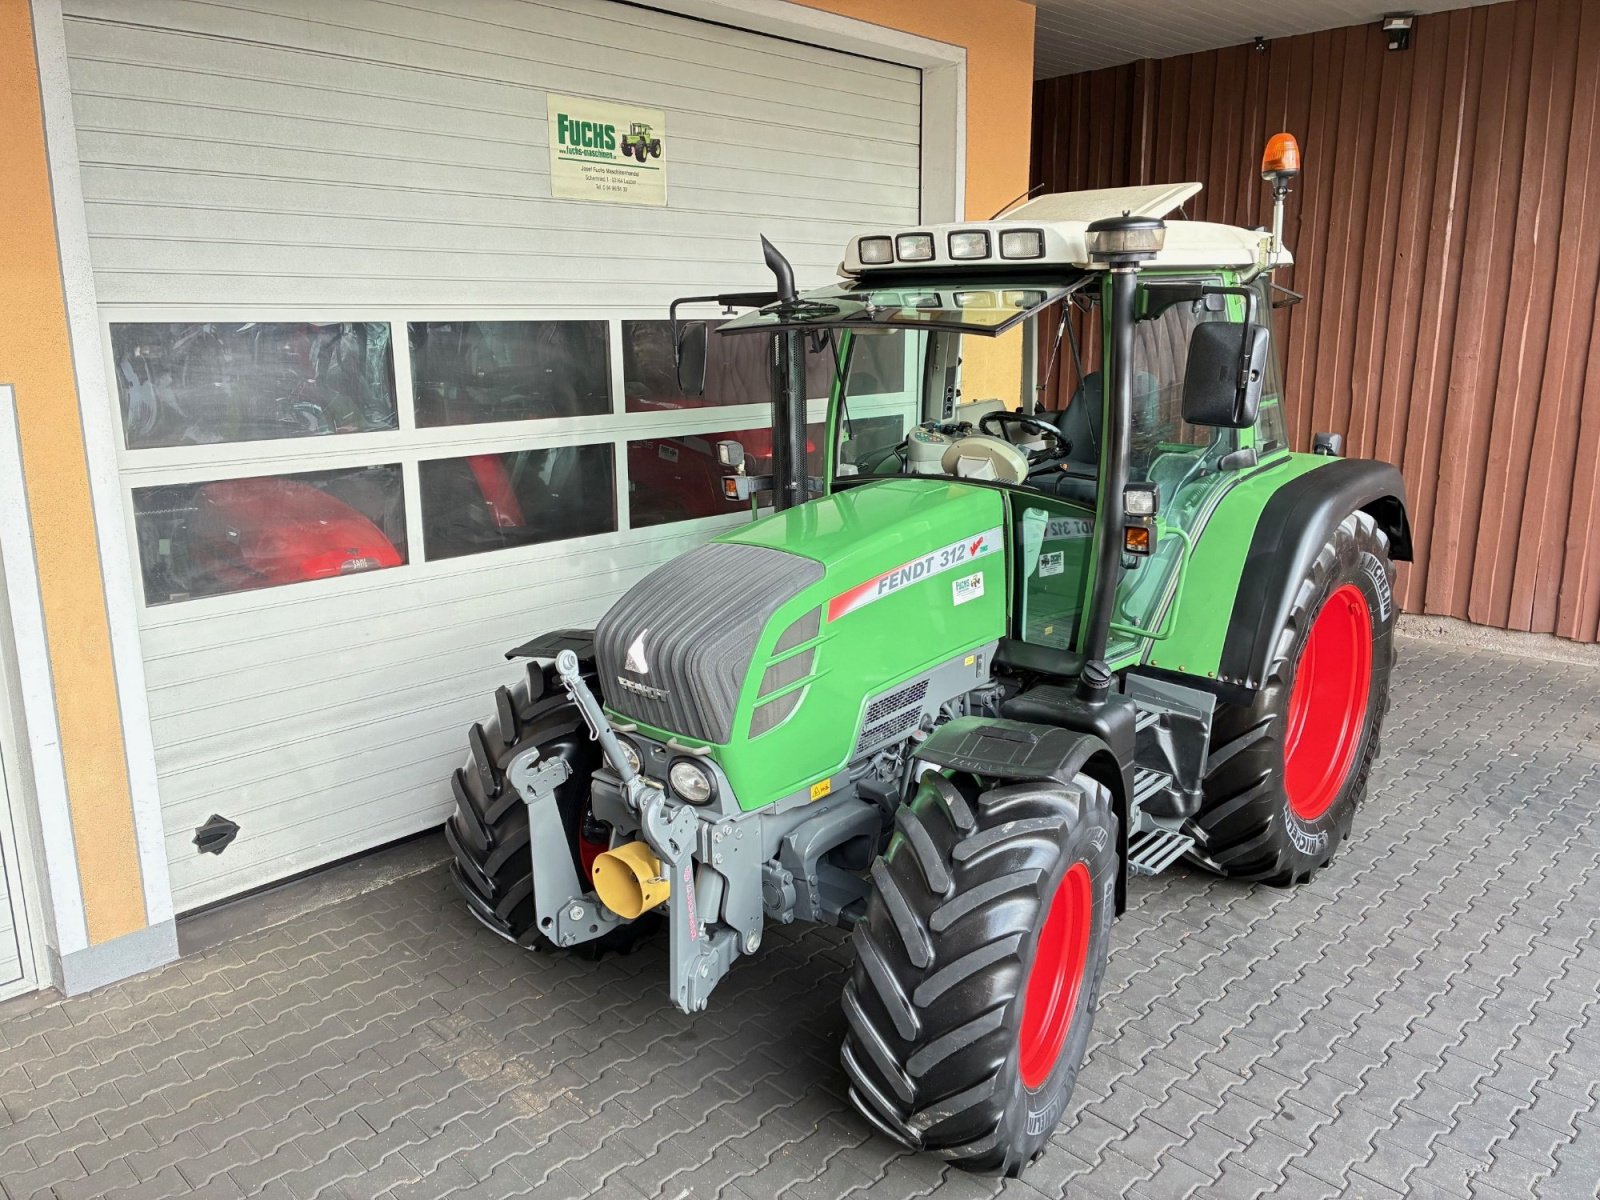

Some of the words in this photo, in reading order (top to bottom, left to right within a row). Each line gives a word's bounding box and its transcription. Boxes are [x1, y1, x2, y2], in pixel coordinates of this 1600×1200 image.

[557, 113, 616, 151] FUCHS
[877, 556, 934, 595] FENDT
[939, 544, 966, 567] 312
[1364, 554, 1392, 617] MICHELIN
